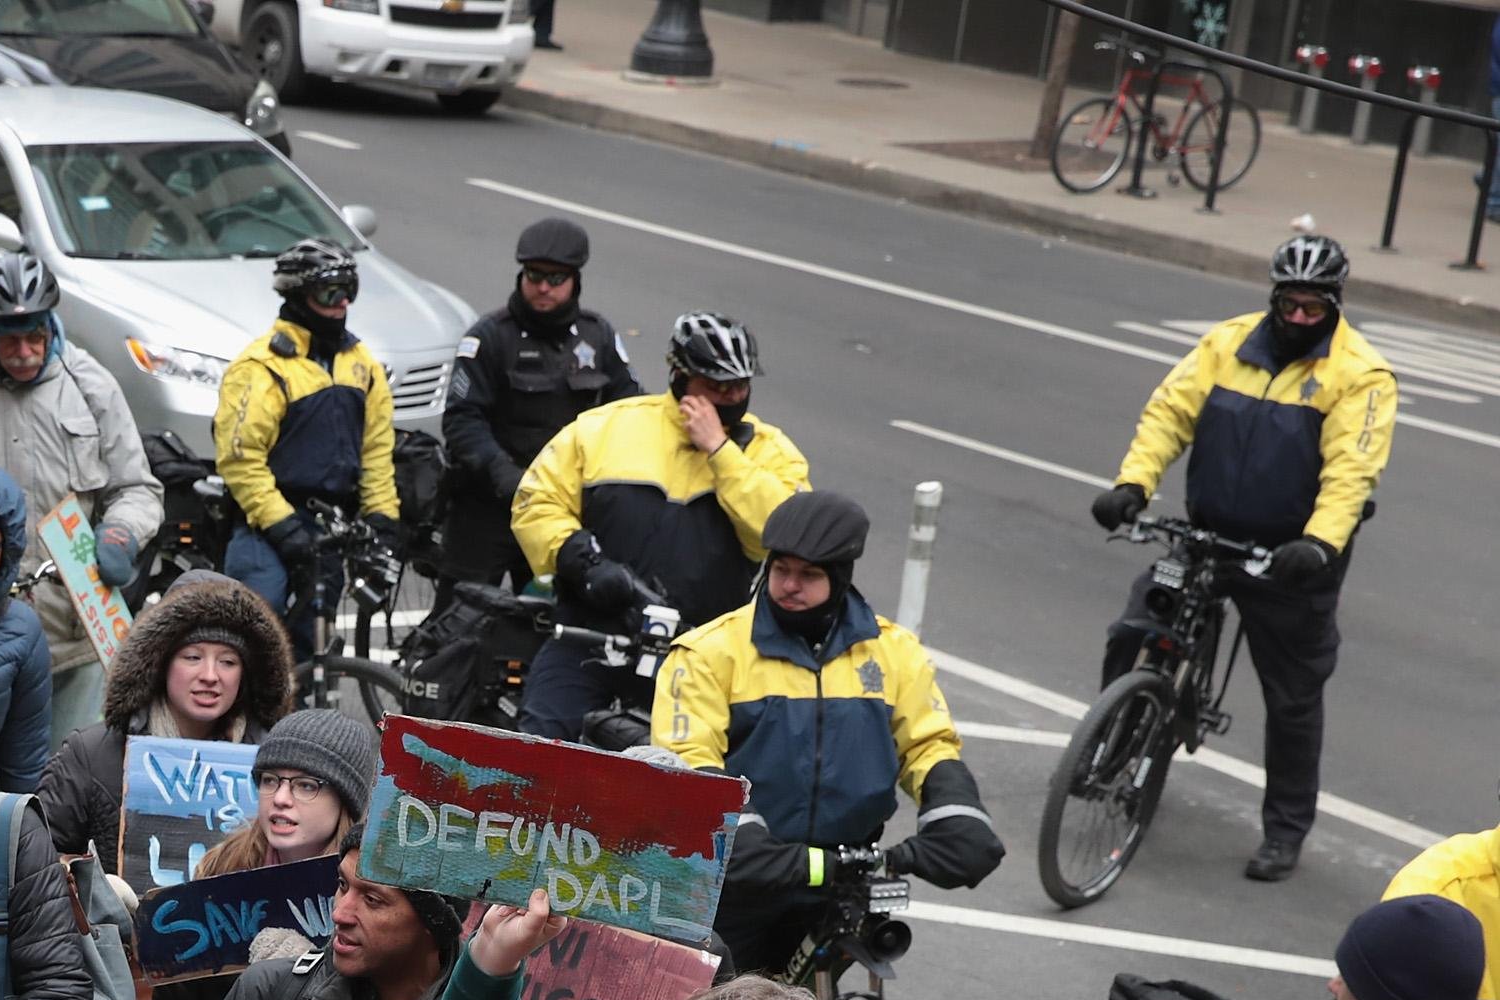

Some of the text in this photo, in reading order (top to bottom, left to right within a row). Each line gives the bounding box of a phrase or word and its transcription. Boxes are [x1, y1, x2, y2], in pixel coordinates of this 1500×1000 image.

[396, 794, 602, 867] DEFUND
[151, 898, 271, 963] SAVE
[545, 867, 714, 938] DAPL
